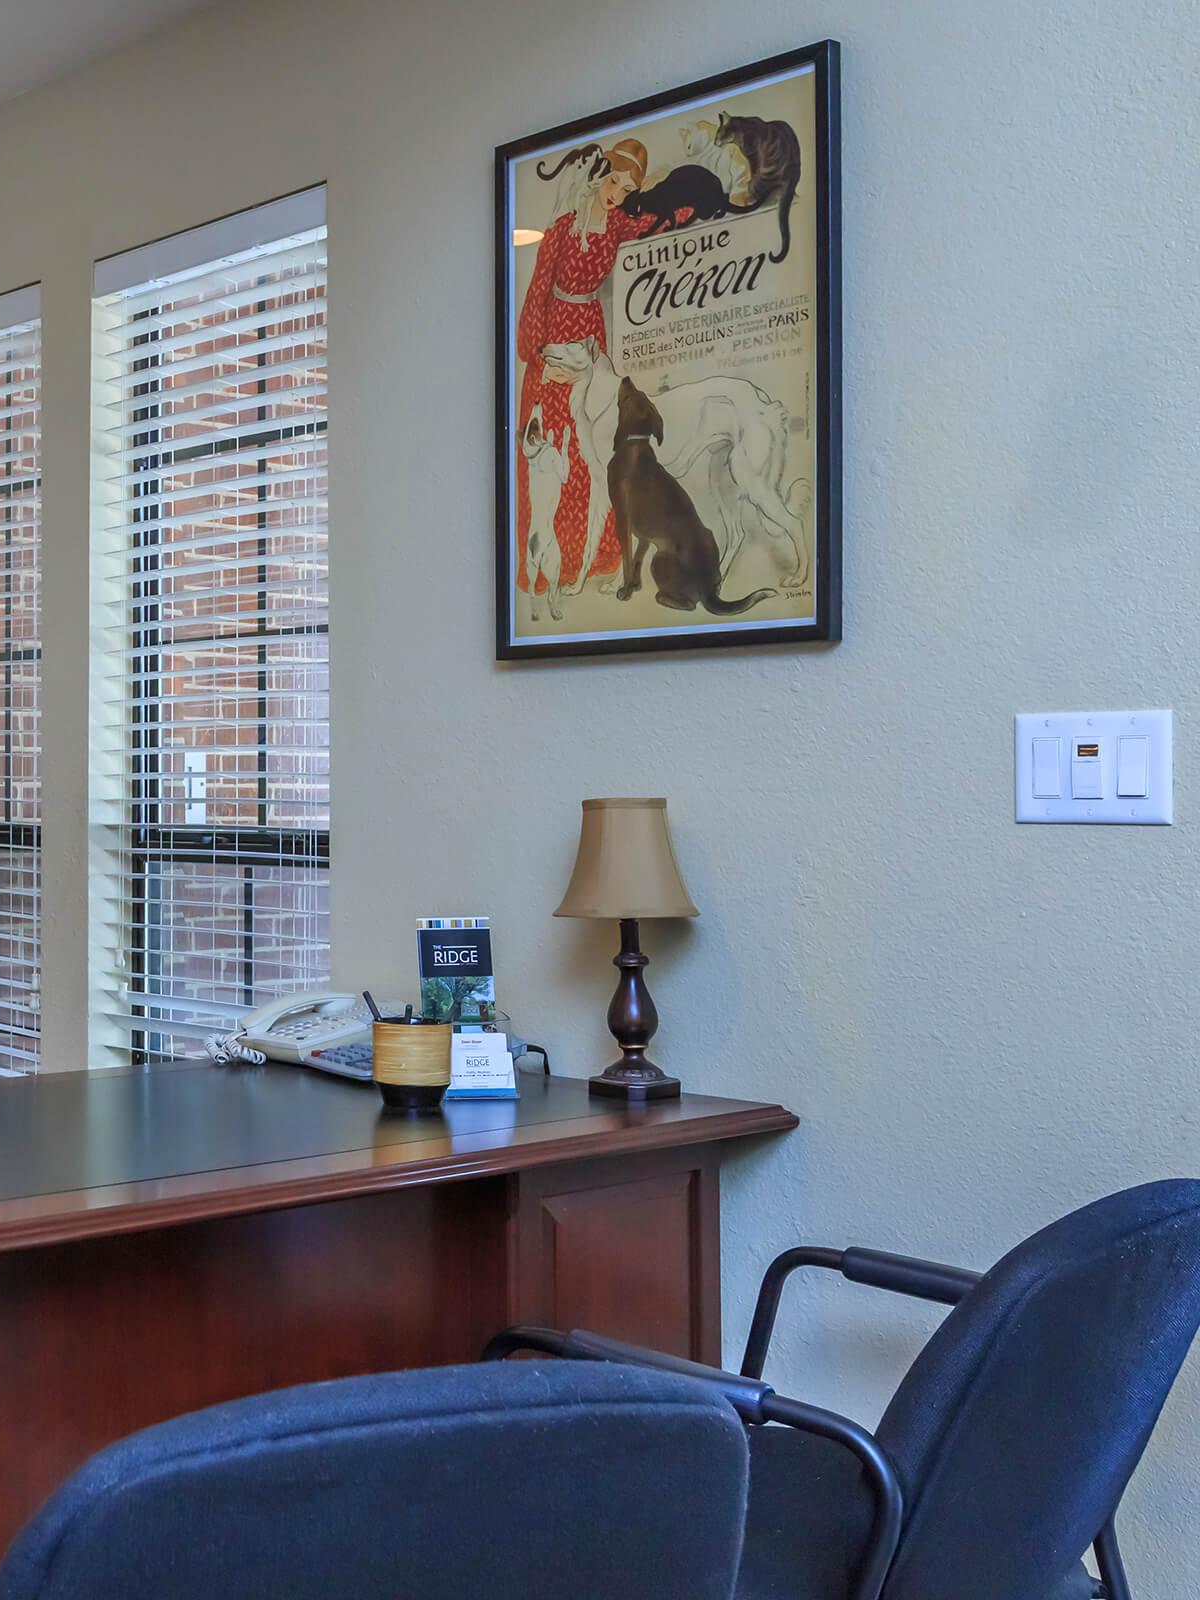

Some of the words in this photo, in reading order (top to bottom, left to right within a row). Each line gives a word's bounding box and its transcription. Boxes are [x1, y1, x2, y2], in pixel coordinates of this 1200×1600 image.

[622, 348, 631, 360] 8
[632, 343, 656, 358] RUE
[657, 341, 673, 353] des
[674, 324, 734, 349] MOULINS
[768, 308, 809, 329] PARIS
[732, 327, 801, 352] PENSION
[434, 950, 478, 963] RIDGE
[466, 1058, 490, 1066] RIDGE
